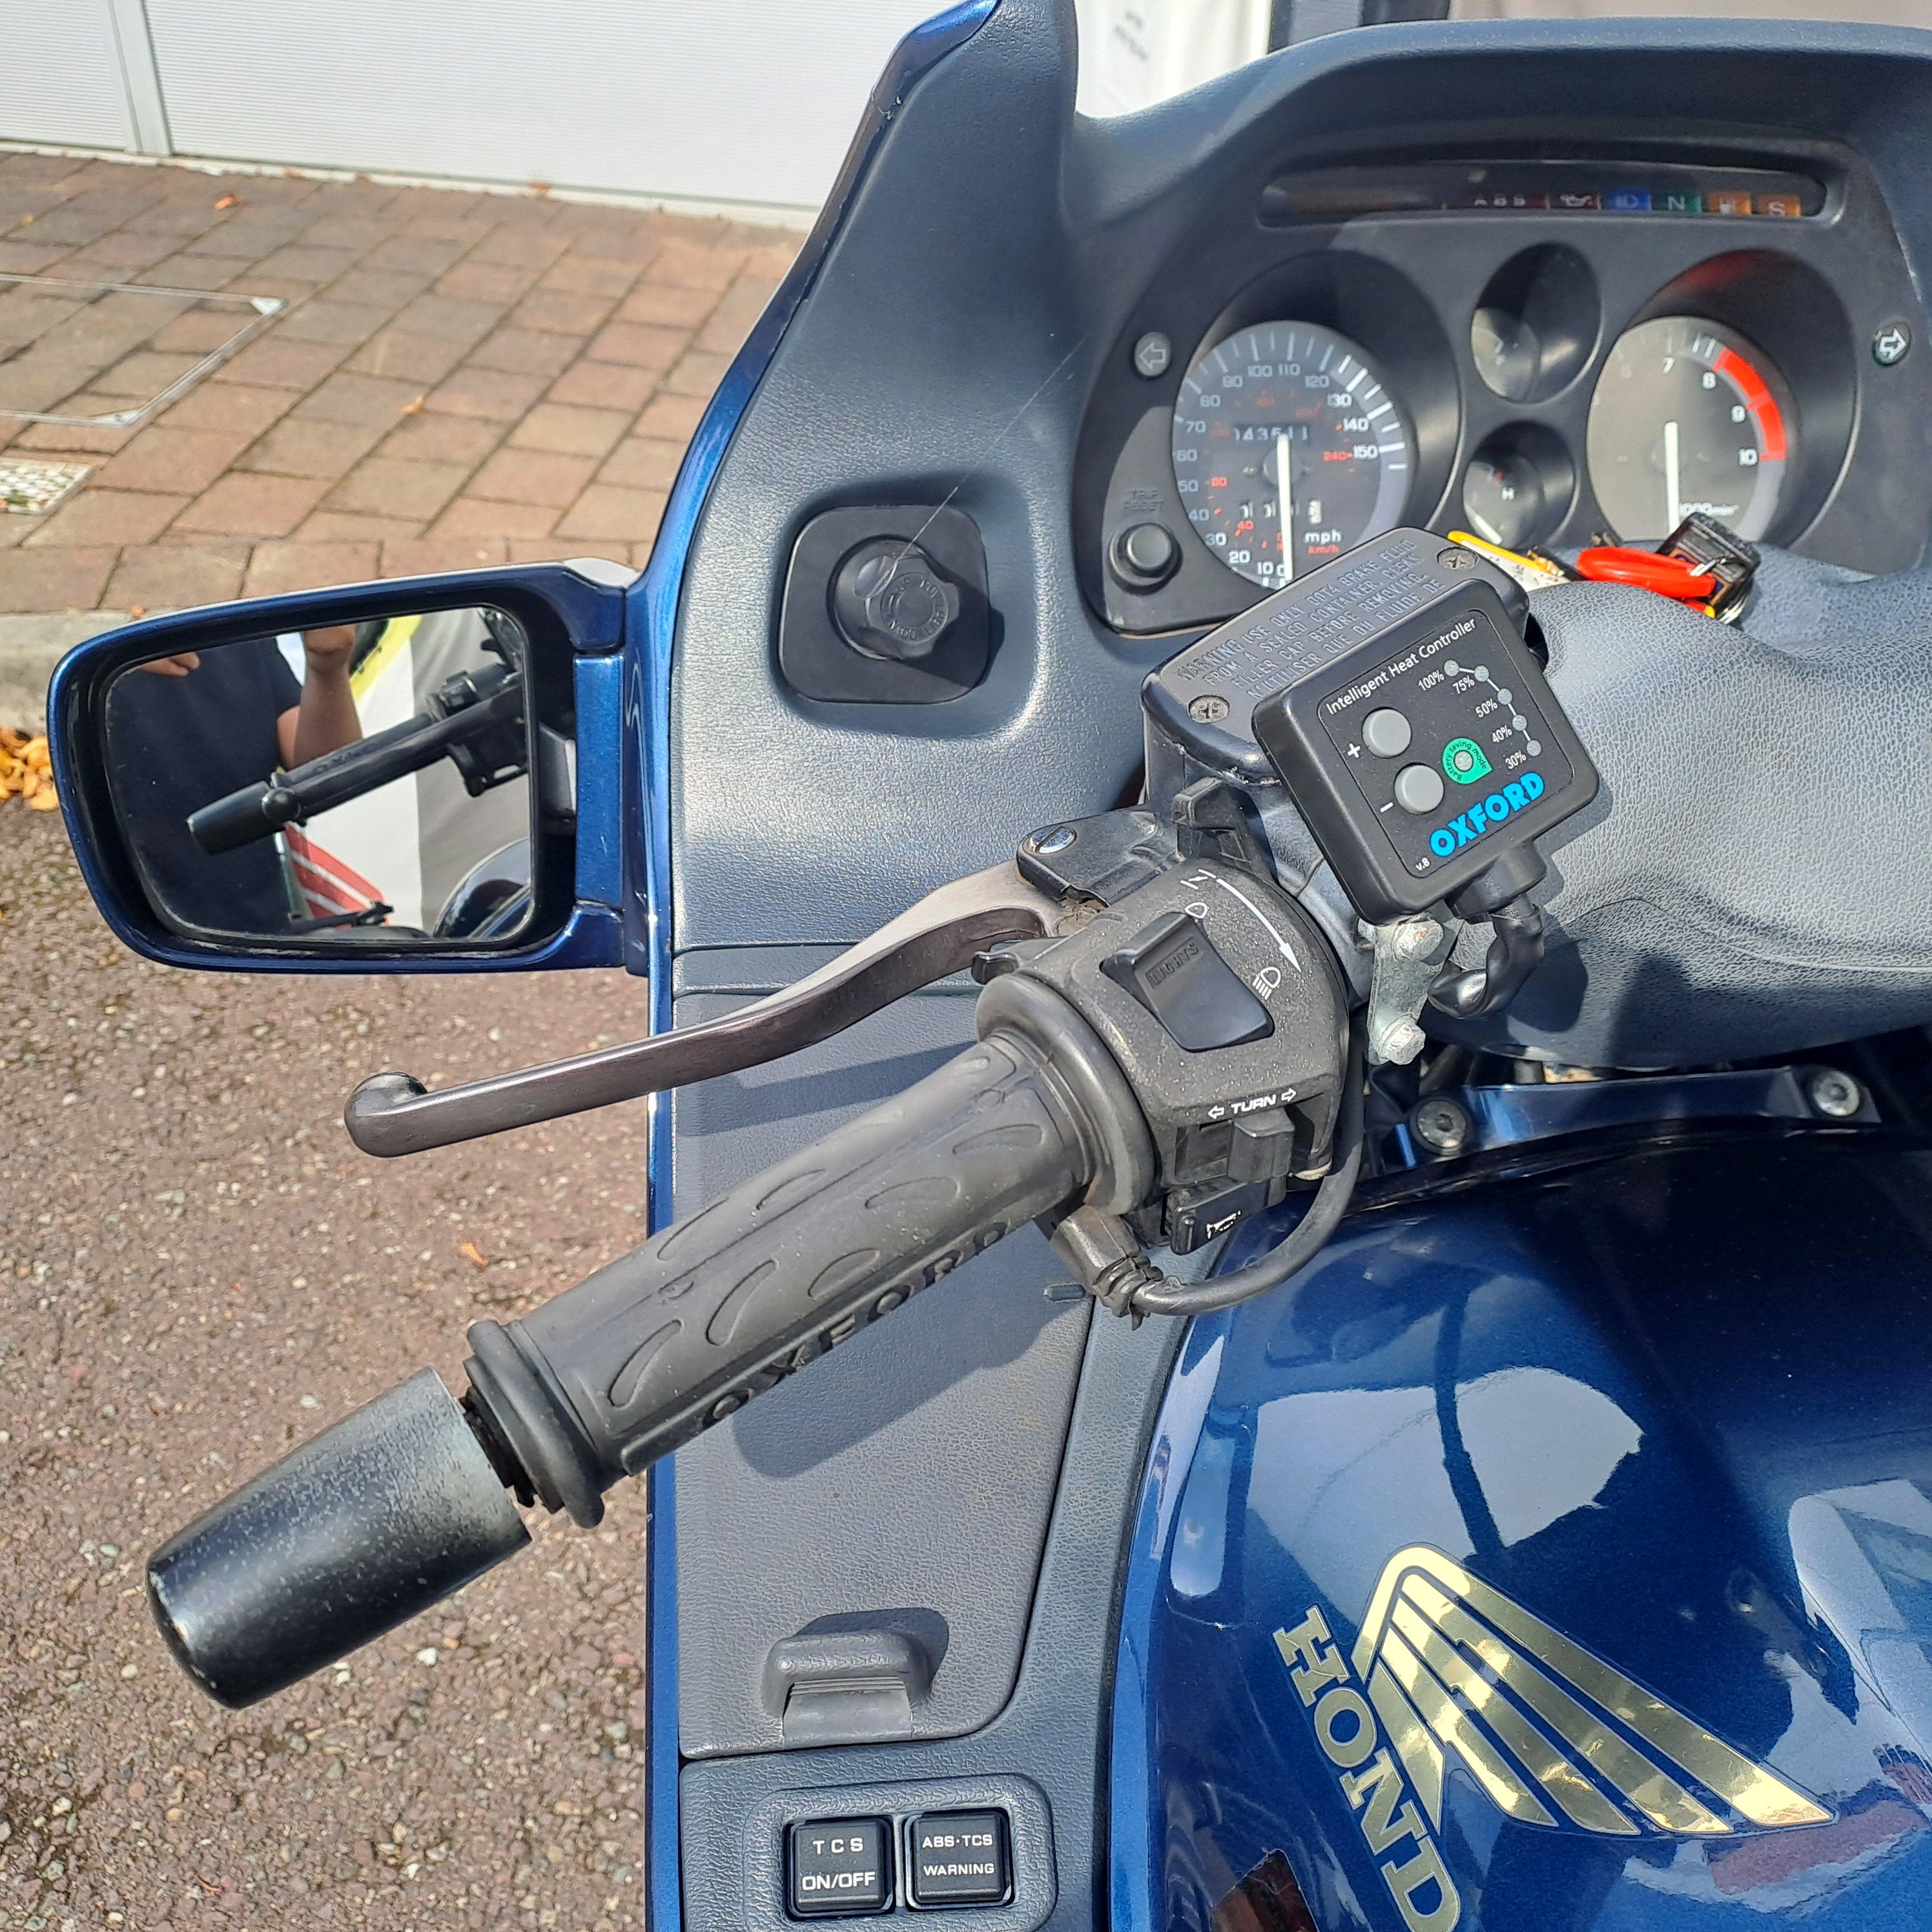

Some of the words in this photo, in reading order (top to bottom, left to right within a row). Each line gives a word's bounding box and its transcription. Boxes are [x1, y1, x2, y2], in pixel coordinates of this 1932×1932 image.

[1667, 195, 1685, 211] N
[1769, 201, 1785, 216] S
[1248, 365, 1273, 377] 100
[1279, 364, 1301, 376] 110
[1663, 357, 1674, 373] 7
[1306, 375, 1330, 387] 120
[1328, 393, 1352, 407] 130
[1186, 422, 1206, 433] 70
[1343, 418, 1370, 431] 140
[1353, 445, 1378, 459] 150
[1738, 447, 1758, 467] 10
[1177, 480, 1199, 493] 50
[1188, 509, 1209, 520] 40
[1206, 533, 1228, 546] 30
[1304, 529, 1342, 544] mph
[1228, 550, 1251, 564] 20
[1257, 561, 1275, 575] 10
[1175, 638, 1244, 681] WARNING
[1240, 624, 1270, 643] USE
[1270, 604, 1304, 626] ONLY
[1337, 559, 1380, 587] BRAKE
[1379, 539, 1416, 562] FLUID
[1322, 633, 1353, 654] QUE
[1352, 621, 1374, 635] DU
[1375, 593, 1424, 622] FLUIDE
[1422, 578, 1444, 594] DE
[1203, 660, 1242, 685] FROM
[1244, 652, 1257, 662] A
[1259, 621, 1307, 653] SEALED
[1231, 659, 1278, 688] FILLER
[1308, 610, 1359, 642] BEFORE
[1326, 670, 1390, 715] Intelligent
[1388, 652, 1419, 677] Heat
[1419, 618, 1477, 659] Controller
[1418, 669, 1445, 692] 100%
[1452, 675, 1475, 695] 75%
[1475, 697, 1499, 718] 50%
[1492, 724, 1513, 743] 40%
[1448, 740, 1472, 753] saving
[1446, 753, 1463, 781] Battery
[1472, 748, 1487, 770] mode
[1505, 750, 1527, 770] 30%
[1429, 771, 1546, 858] OXFORD
[1149, 942, 1199, 987] LIGHTS
[1230, 1094, 1277, 1115] TURN
[1272, 1604, 1461, 1932] HOND
[923, 1863, 995, 1876] WARNING
[802, 1871, 876, 1891] ON/OFF
